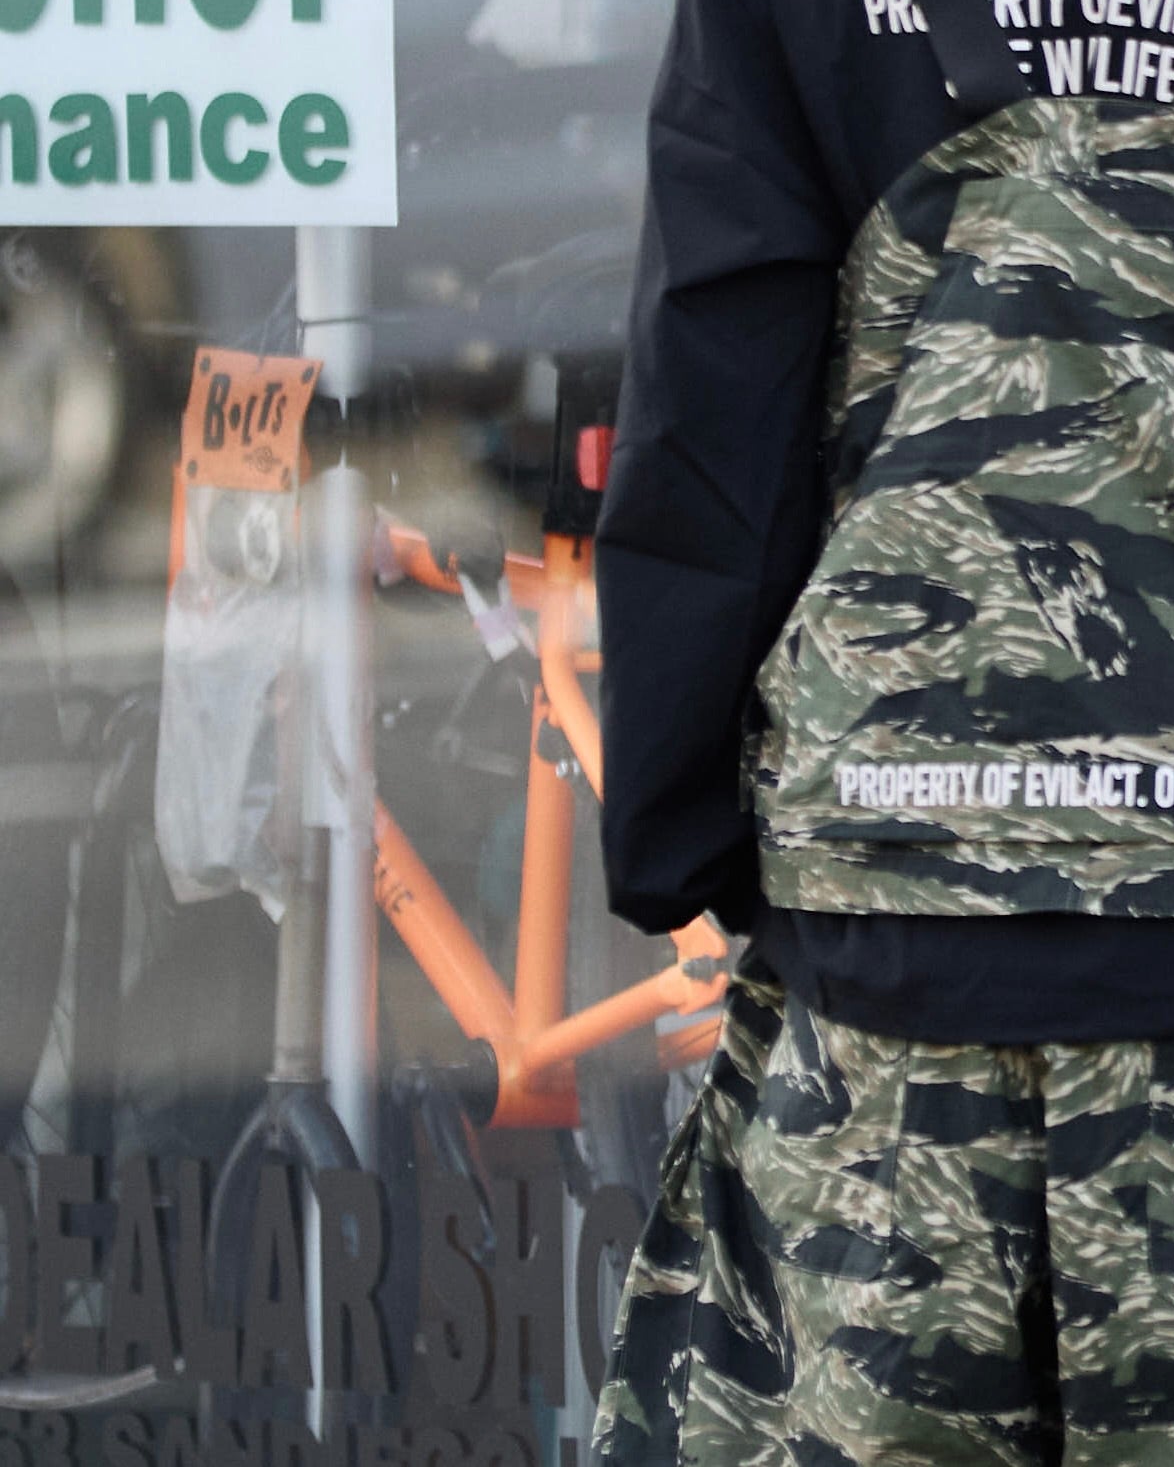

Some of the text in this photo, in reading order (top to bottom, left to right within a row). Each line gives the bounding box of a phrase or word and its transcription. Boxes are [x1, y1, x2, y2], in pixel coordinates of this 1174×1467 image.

[838, 762, 980, 807] PROPERTY
[981, 763, 1023, 807] OF
[1024, 763, 1149, 808] EVILACT.
[415, 1174, 647, 1408] SHO
